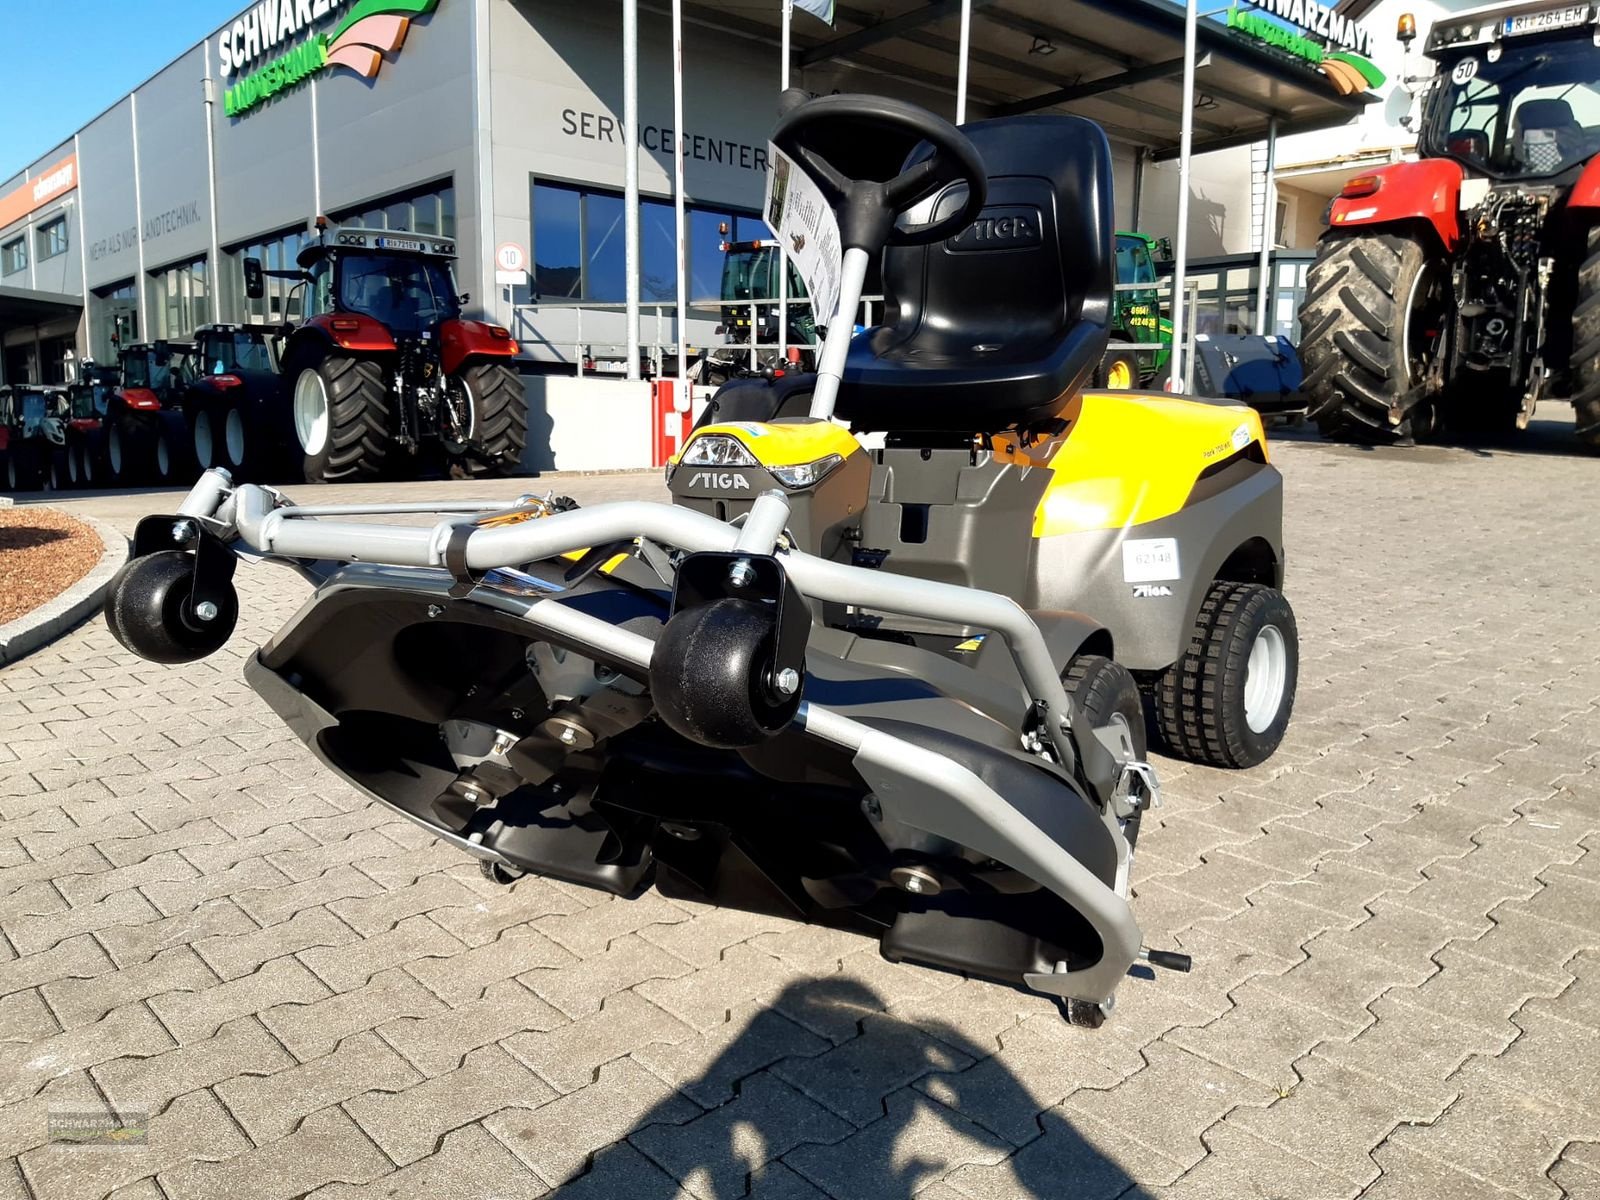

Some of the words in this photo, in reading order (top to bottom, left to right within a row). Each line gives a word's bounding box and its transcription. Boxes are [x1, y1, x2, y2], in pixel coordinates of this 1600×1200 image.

[1515, 16, 1527, 29] RI
[1537, 11, 1561, 26] 264
[1565, 6, 1583, 21] EM
[219, 0, 344, 77] SCHWAR
[1456, 61, 1474, 80] 50
[109, 232, 121, 254] ALS
[142, 200, 201, 243] LANDTECHNIK.
[505, 250, 516, 265] 10
[688, 472, 750, 490] STIGA
[1136, 552, 1172, 565] 62148
